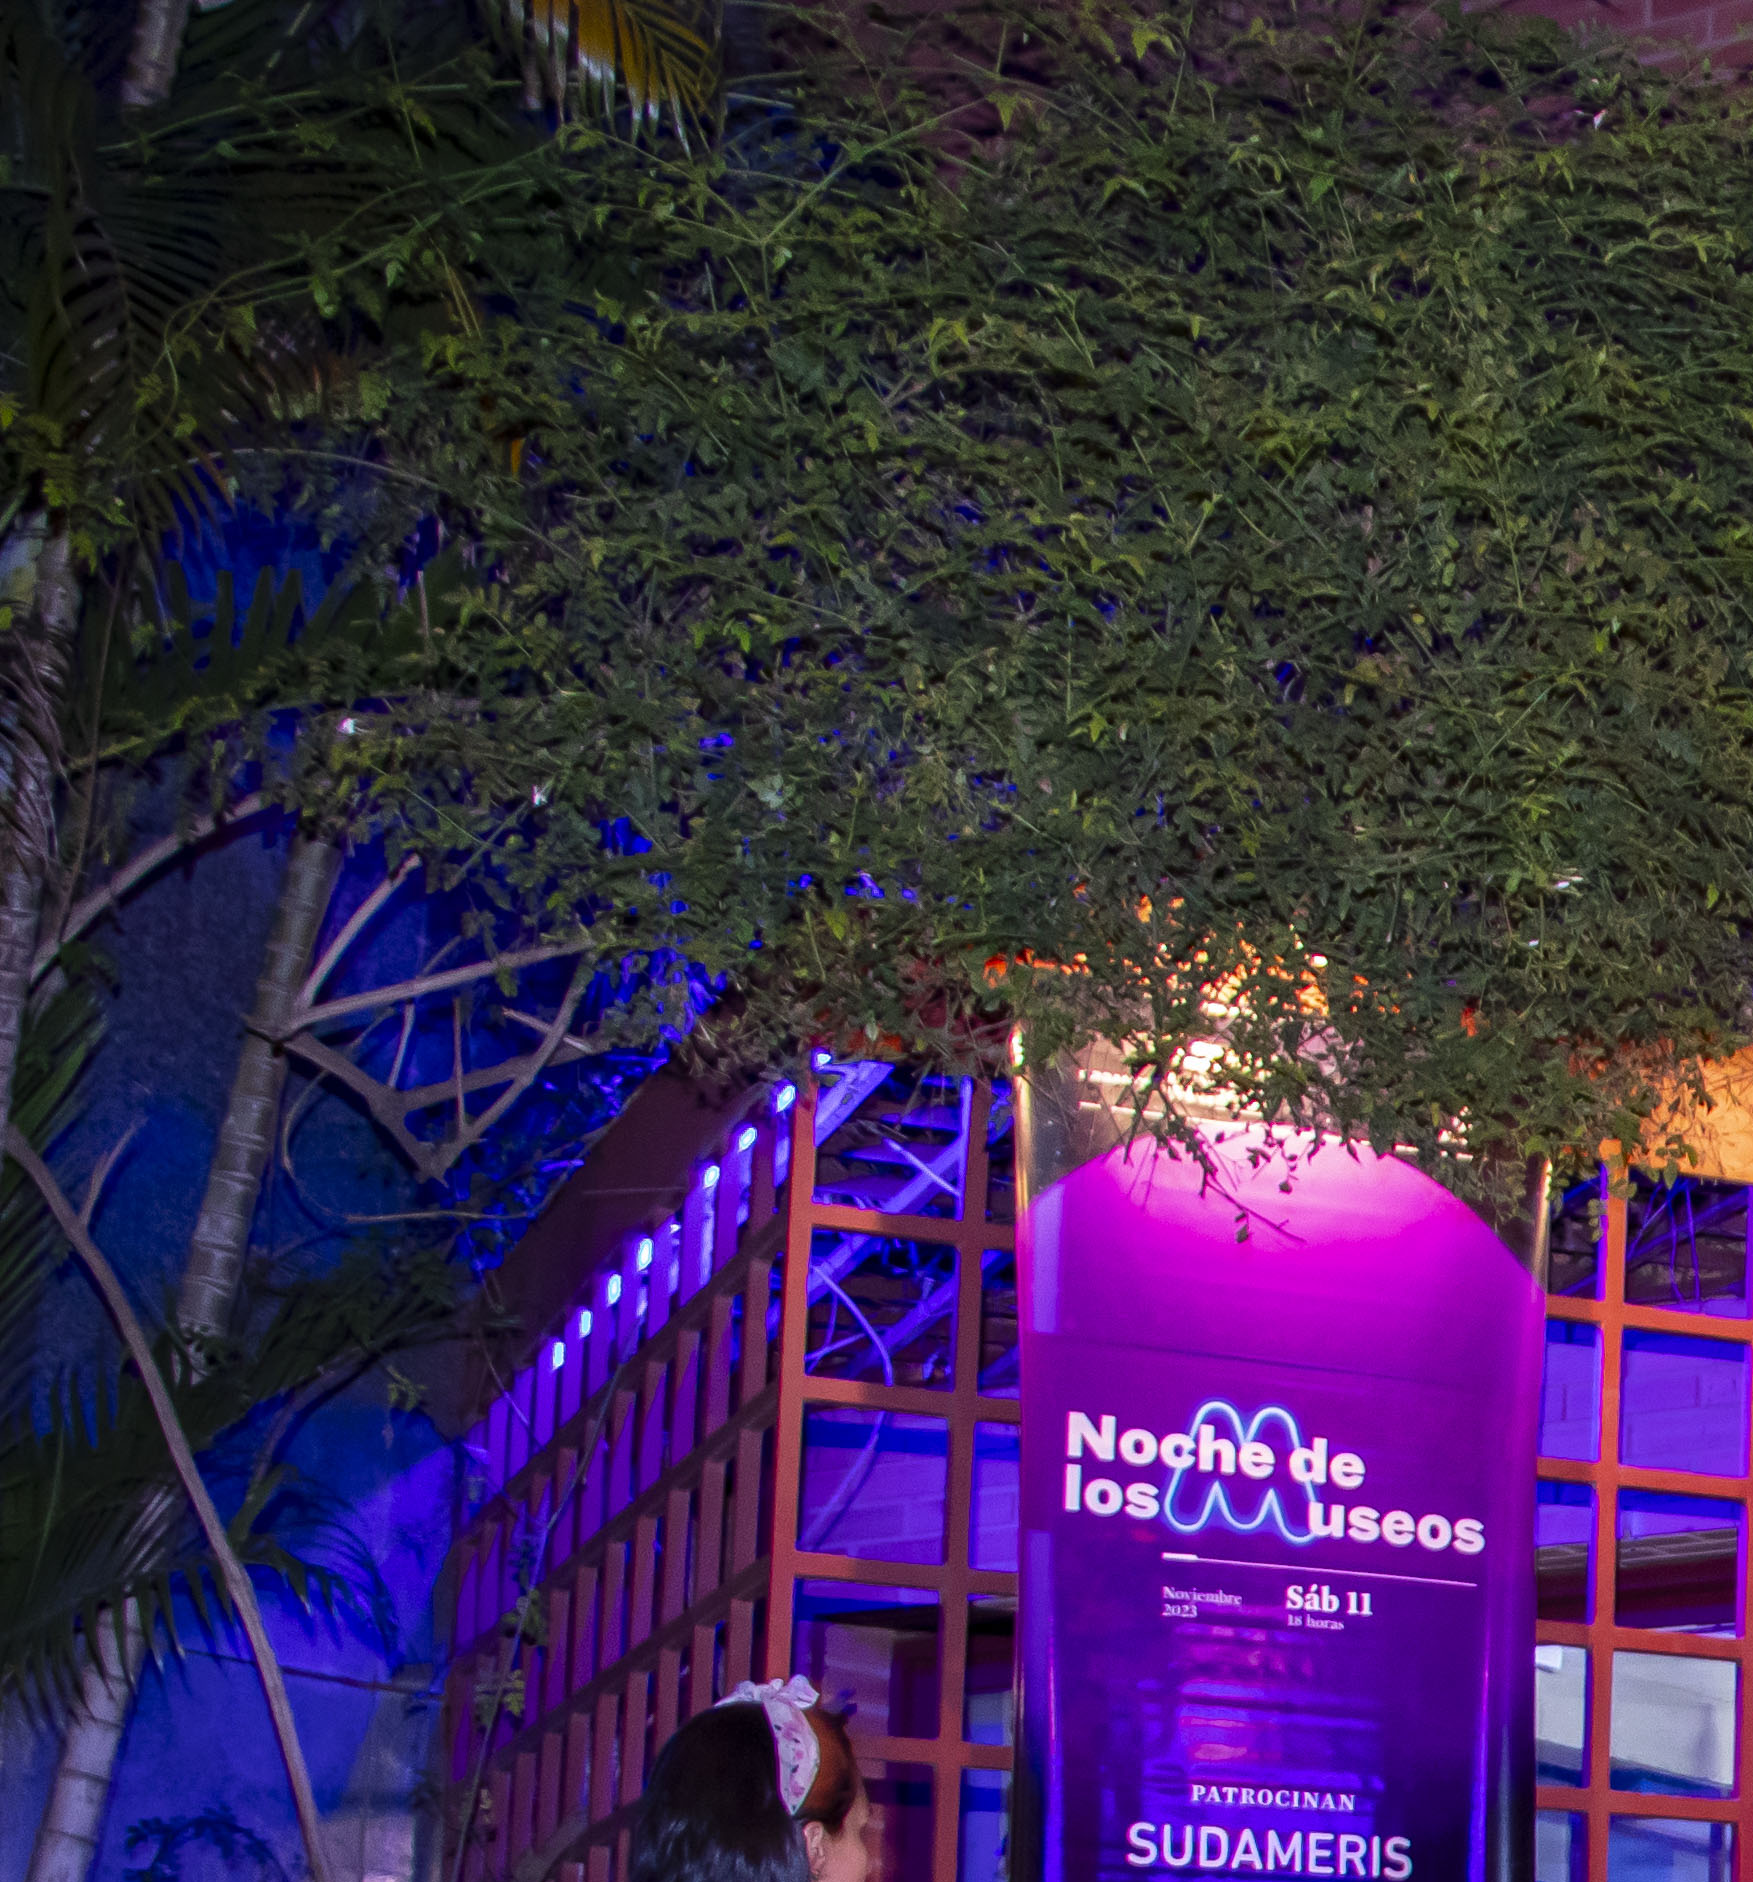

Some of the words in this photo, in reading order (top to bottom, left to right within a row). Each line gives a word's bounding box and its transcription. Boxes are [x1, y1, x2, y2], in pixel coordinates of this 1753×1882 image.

[1065, 1411, 1276, 1478] Noche
[1289, 1437, 1366, 1489] de
[1064, 1463, 1160, 1519] los
[1162, 1586, 1243, 1606] Noviembre
[1162, 1603, 1198, 1618] 2023
[1286, 1584, 1340, 1614] Sáb
[1346, 1591, 1373, 1616] 11
[1287, 1614, 1303, 1627] 18
[1306, 1614, 1345, 1630] horas
[1191, 1785, 1356, 1811] PATROCINAN
[1126, 1821, 1413, 1880] SUDAMERIS
